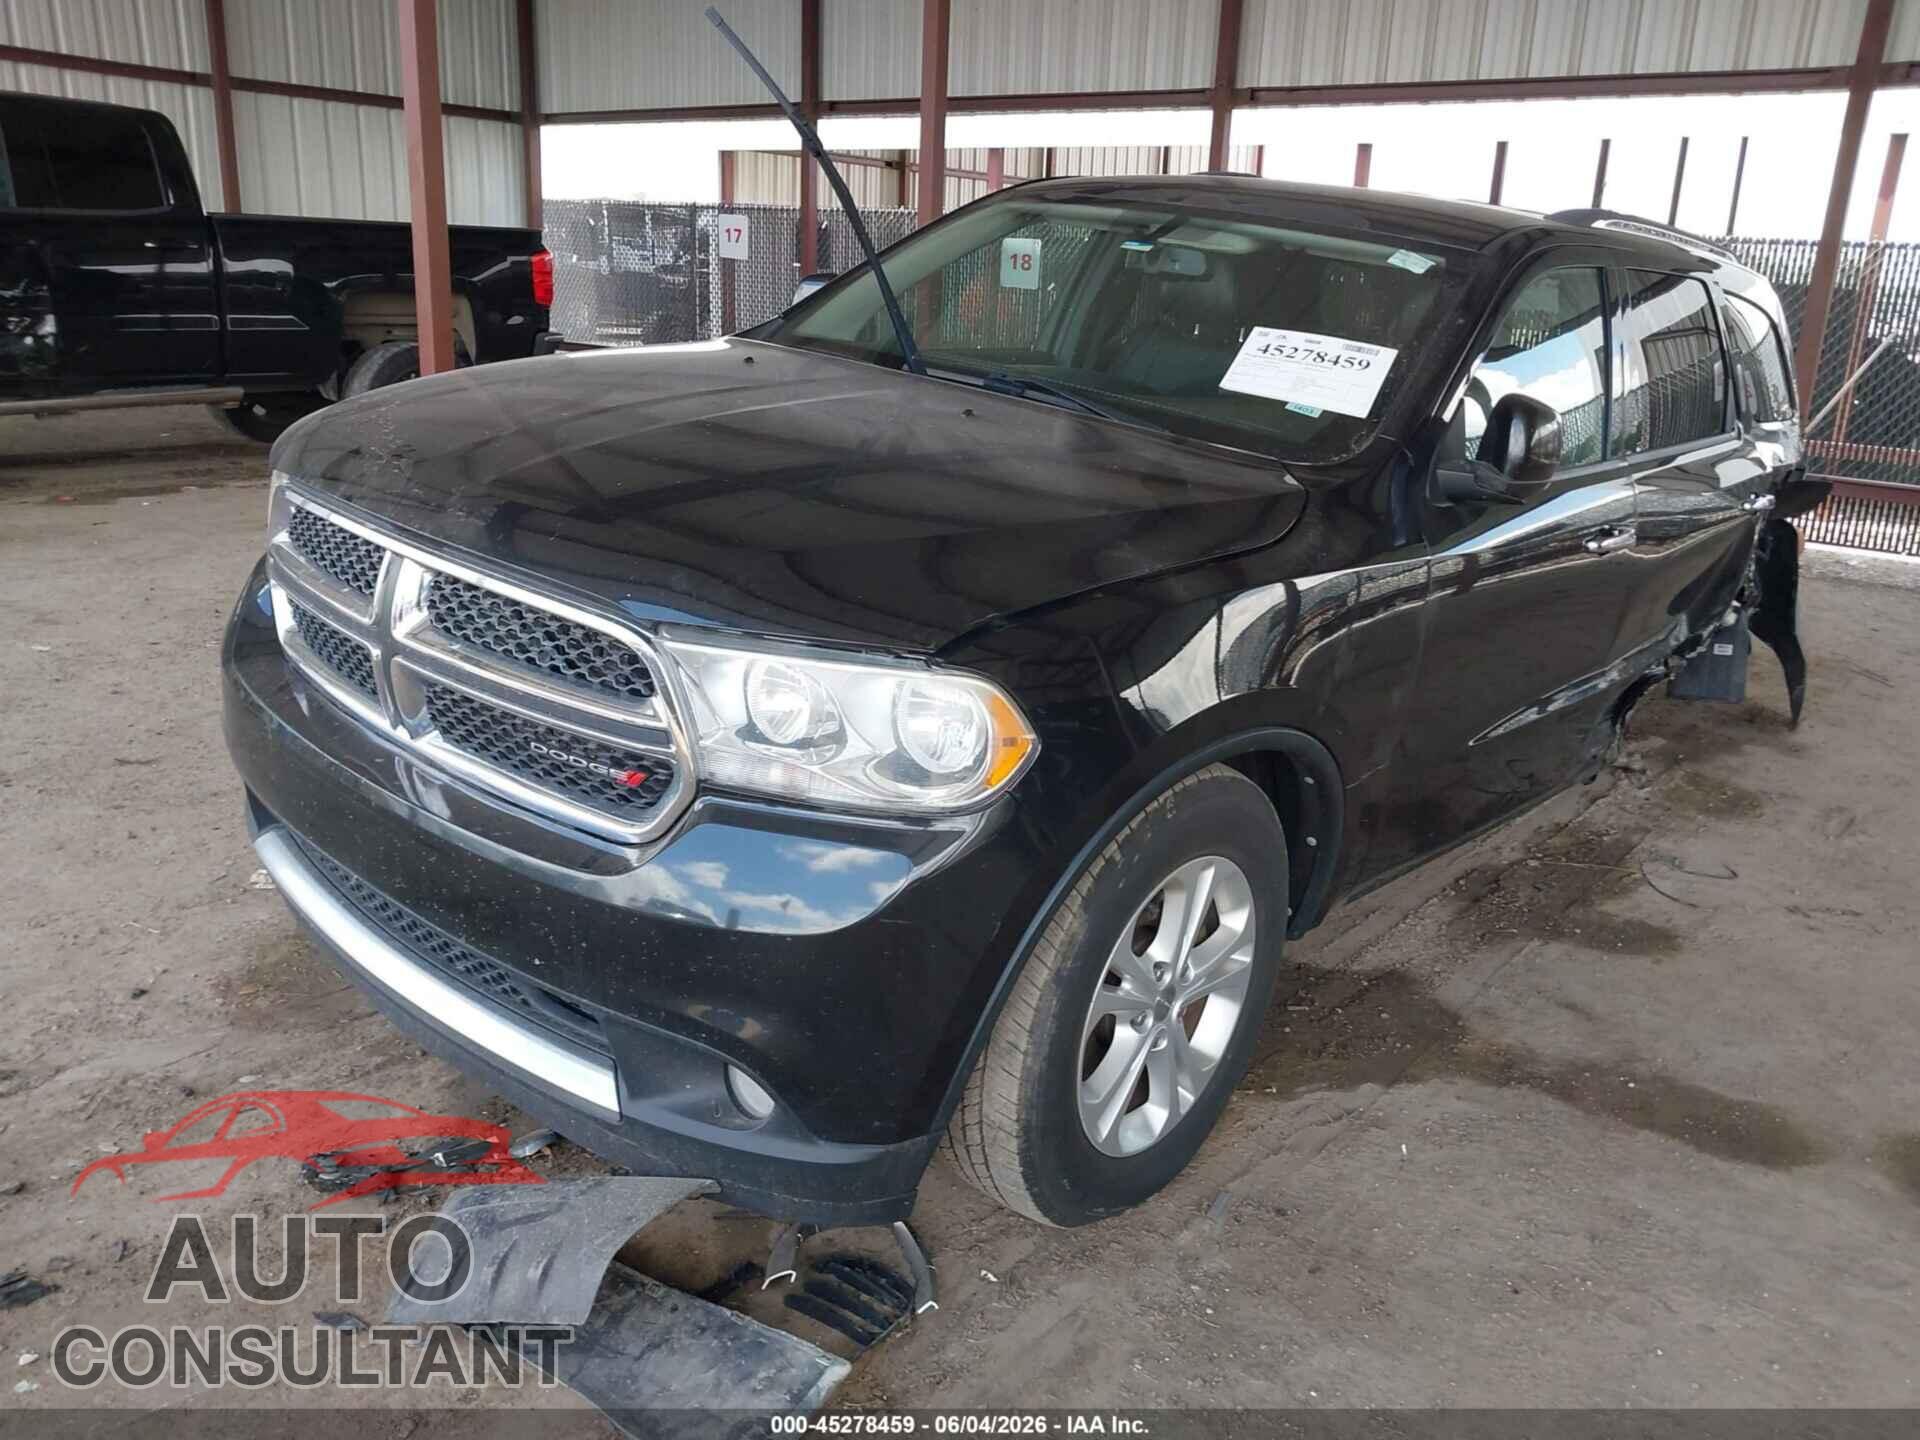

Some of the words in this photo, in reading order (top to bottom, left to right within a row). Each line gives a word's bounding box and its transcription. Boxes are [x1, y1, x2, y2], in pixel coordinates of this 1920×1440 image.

[725, 228, 742, 243] 17
[1010, 253, 1032, 271] 18
[1257, 343, 1371, 372] 45278459
[530, 742, 629, 784] DODGE
